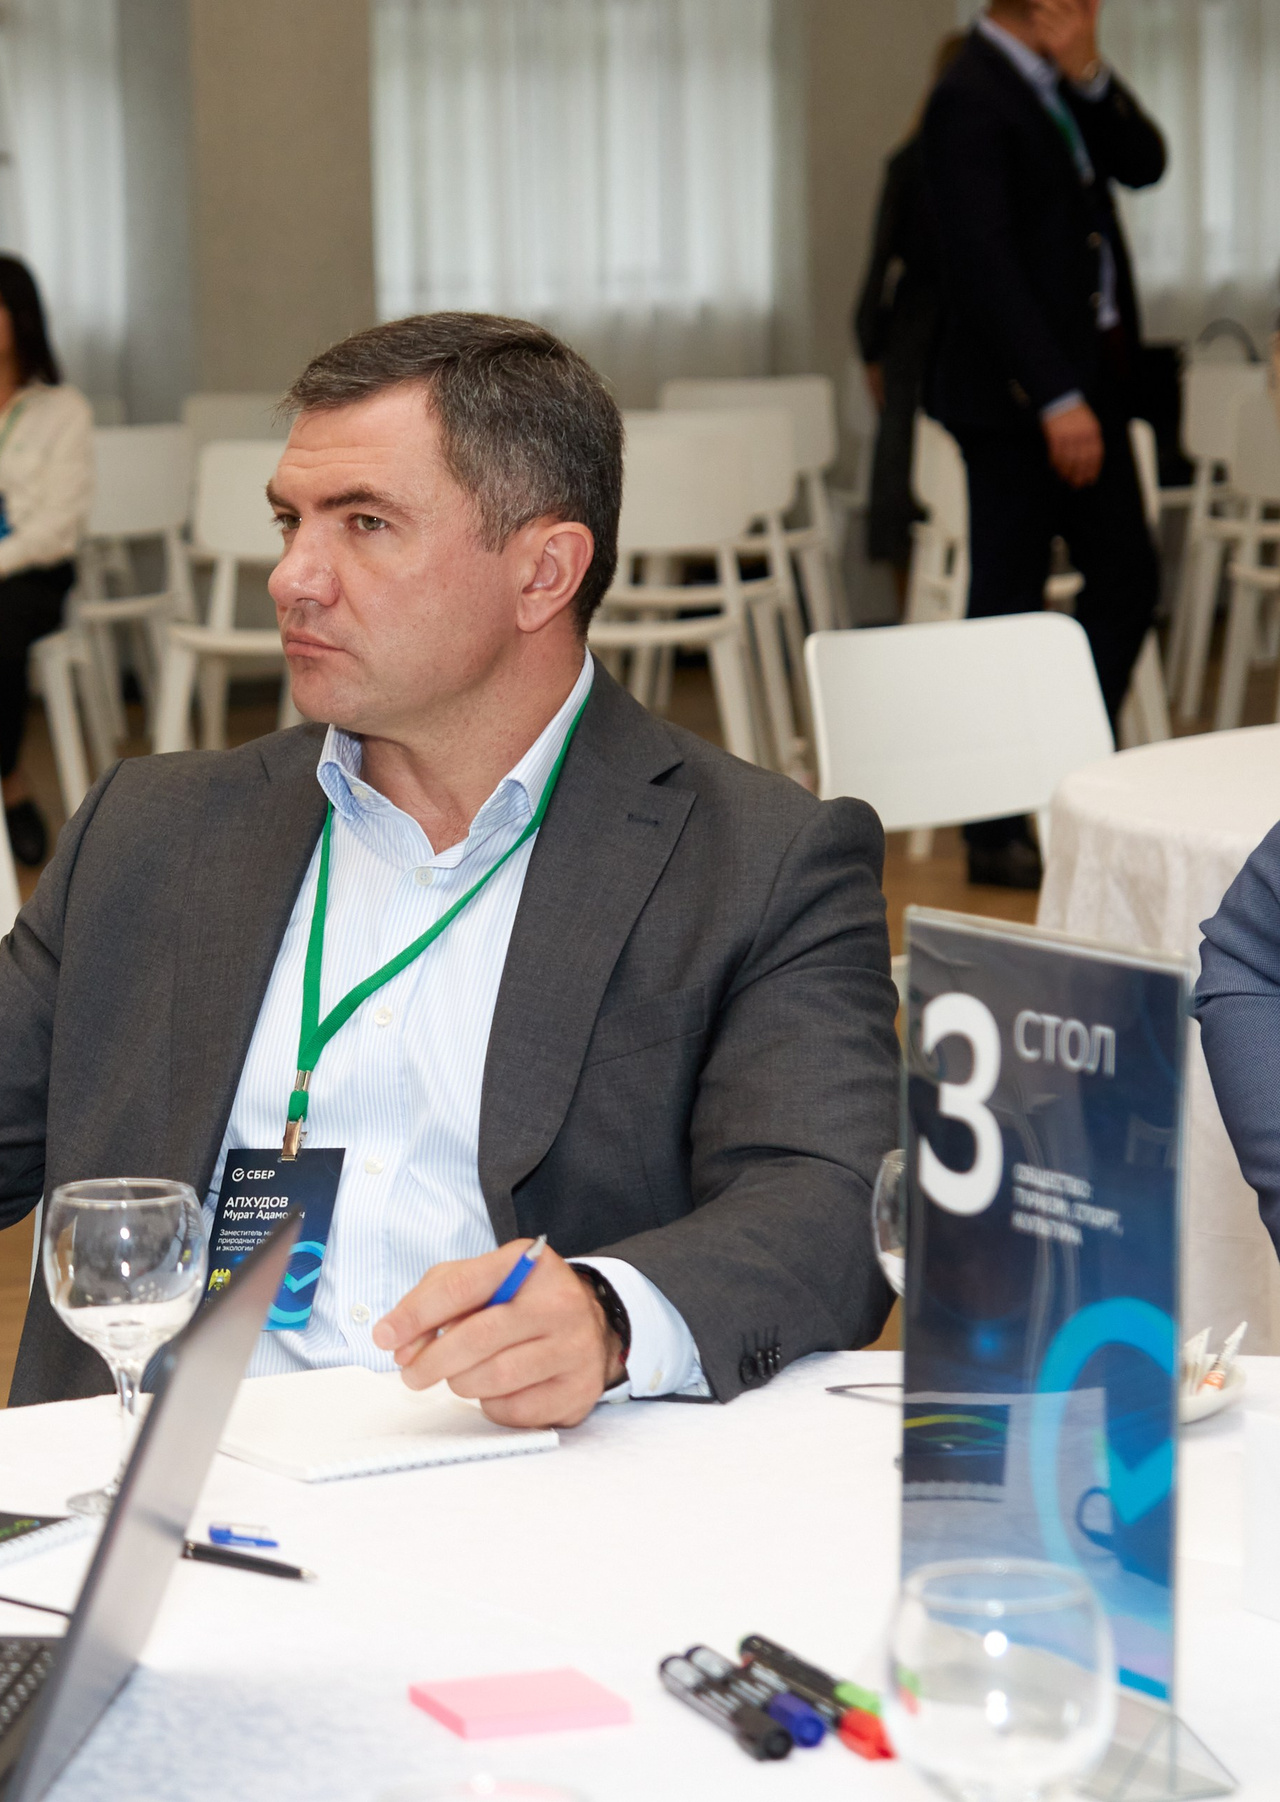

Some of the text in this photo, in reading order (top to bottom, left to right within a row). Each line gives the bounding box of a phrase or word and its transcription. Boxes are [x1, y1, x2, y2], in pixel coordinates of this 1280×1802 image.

[1013, 1010, 1116, 1079] СТОЛ
[918, 992, 1003, 1217] 3
[246, 1170, 276, 1180] СБЕР
[225, 1196, 289, 1209] АПХУДОВ
[223, 1210, 305, 1221] Мурат Адамоч
[220, 1228, 263, 1237] Заместитель
